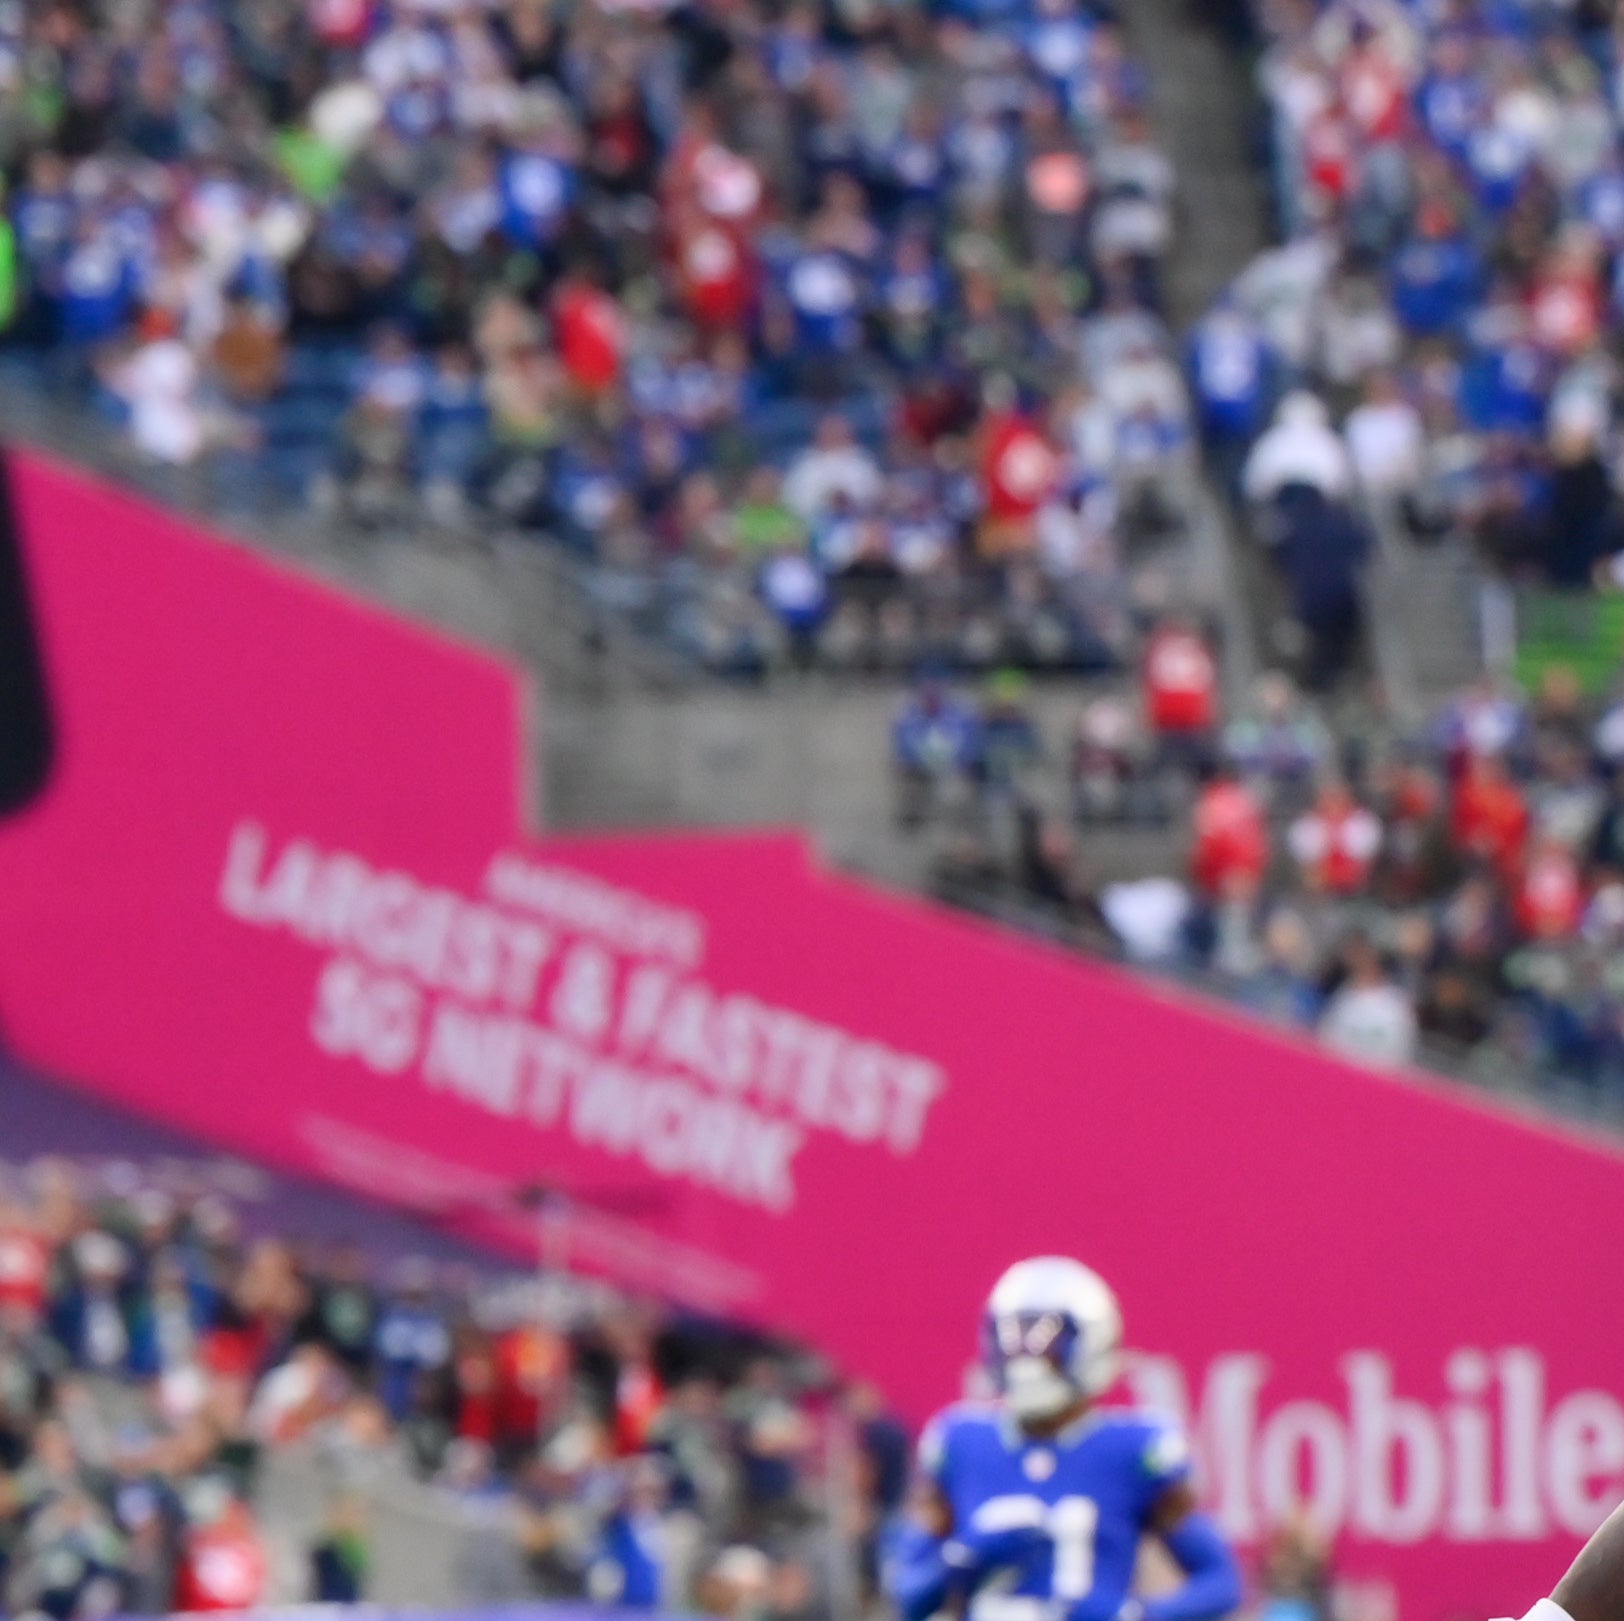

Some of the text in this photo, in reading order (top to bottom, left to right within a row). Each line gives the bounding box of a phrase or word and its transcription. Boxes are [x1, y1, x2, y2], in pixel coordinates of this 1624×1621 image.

[223, 816, 944, 1158] LARGEST & FASTEST
[421, 1000, 802, 1218] NETWORK
